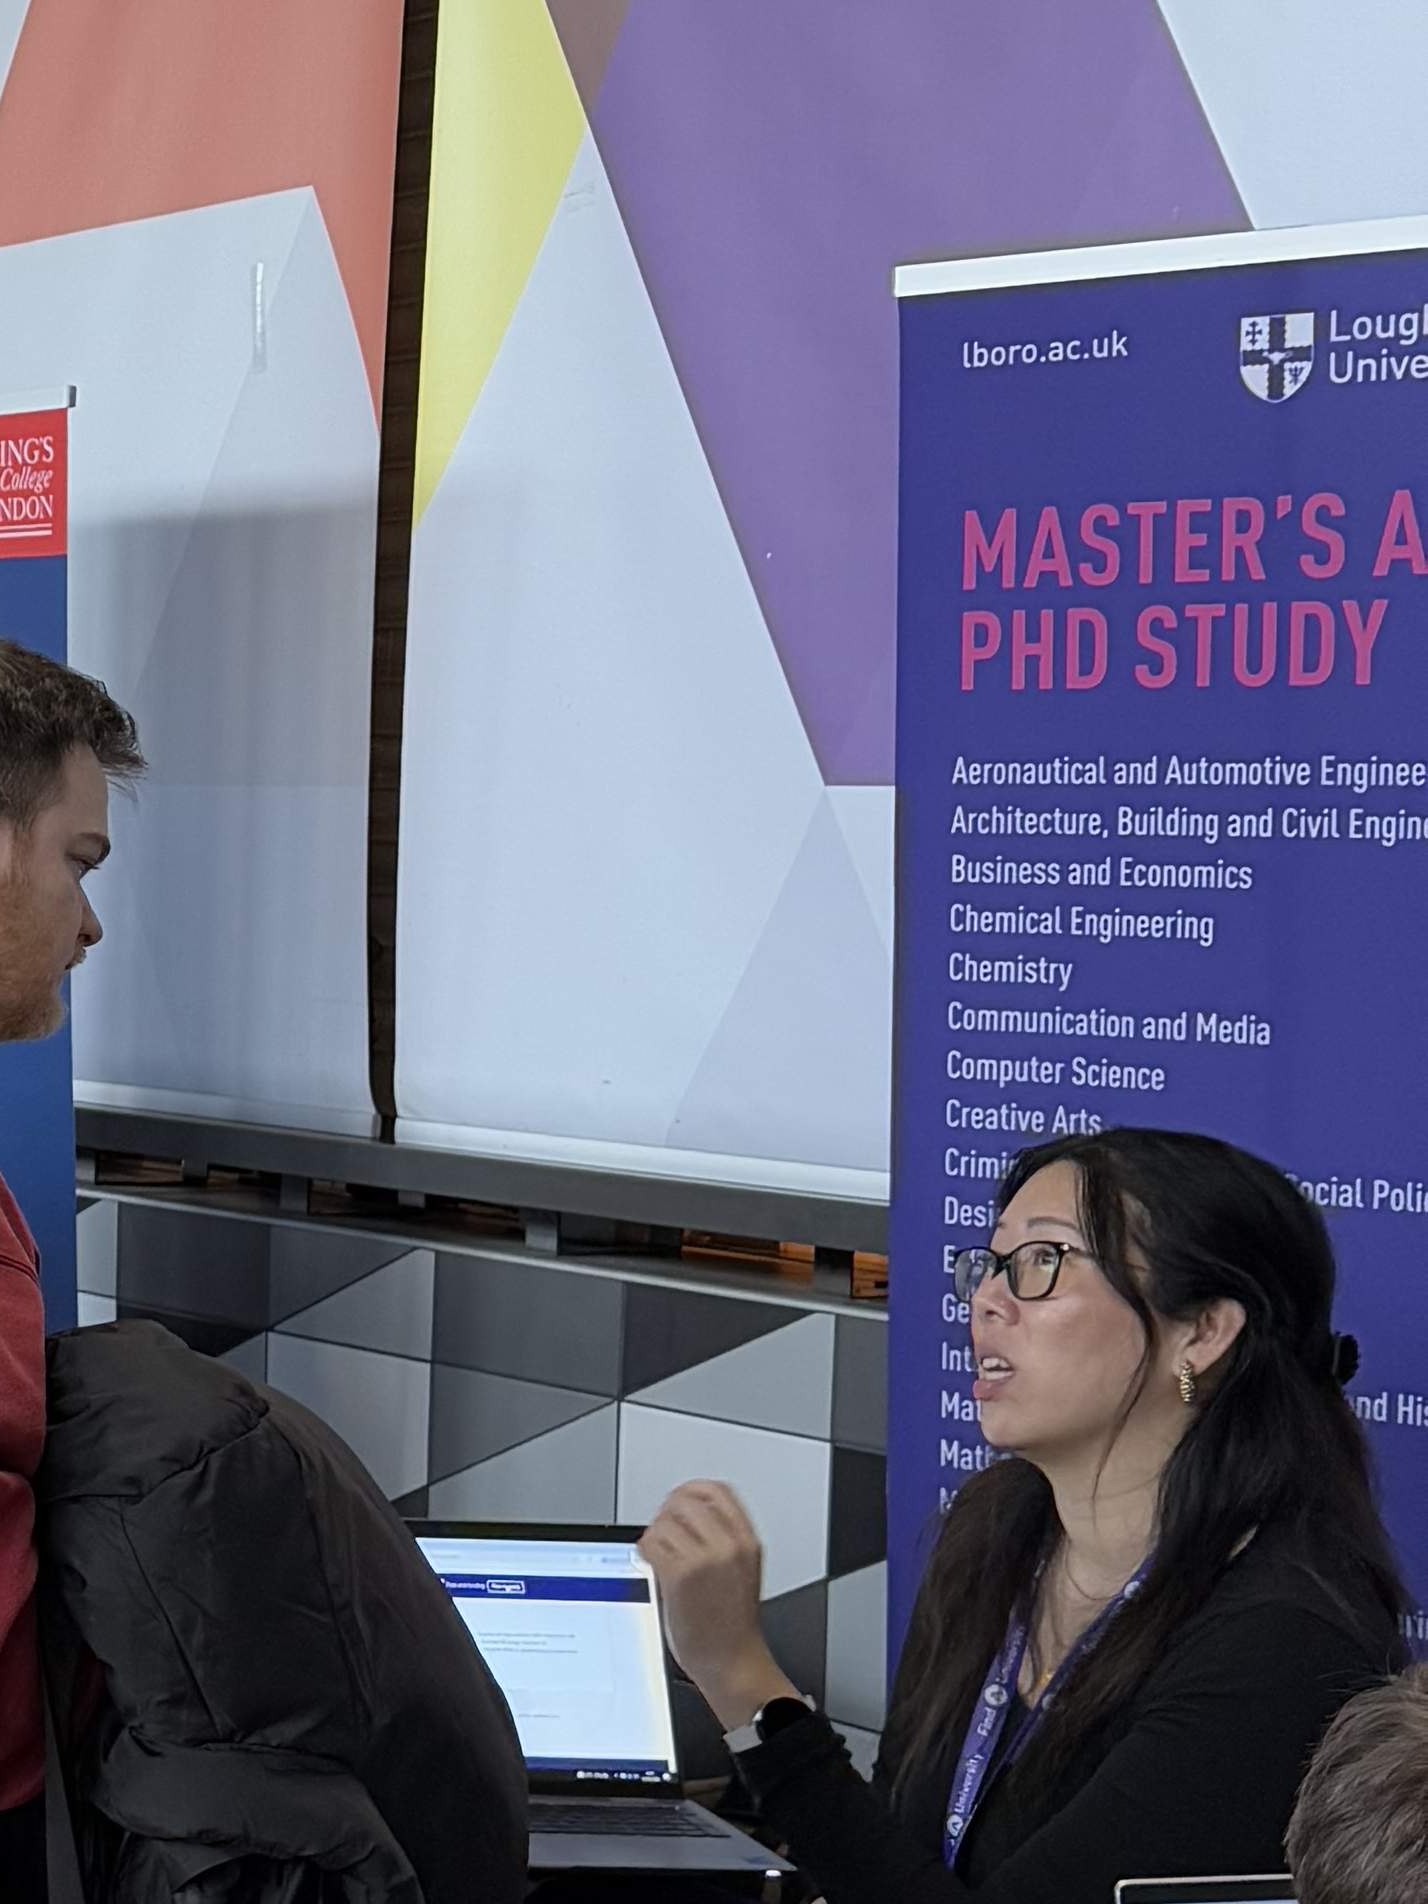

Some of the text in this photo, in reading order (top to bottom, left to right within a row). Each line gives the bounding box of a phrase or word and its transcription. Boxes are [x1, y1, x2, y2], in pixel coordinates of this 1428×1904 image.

[1329, 303, 1428, 345] Loug
[963, 329, 1128, 369] lboro.ac.uk
[0, 467, 53, 493] College
[962, 492, 1346, 592] MASTER'S
[960, 598, 1389, 691] PHD STUDY
[951, 755, 1107, 785] Aeronautical
[1113, 755, 1157, 785] and
[1164, 755, 1311, 786] Automotive
[950, 805, 1109, 839] Architecture,
[1117, 806, 1219, 845] Building
[1227, 807, 1273, 838] and
[1282, 807, 1341, 839] Civil
[951, 854, 1253, 889] Business and Economics
[950, 903, 1214, 947] Chemical Engineering
[949, 952, 1073, 992] Chemistry
[948, 1001, 1271, 1046] Communication and Media
[946, 1049, 1165, 1091] Computer Science
[946, 1098, 1102, 1136] Creative Arts
[1286, 1173, 1364, 1208] ocial
